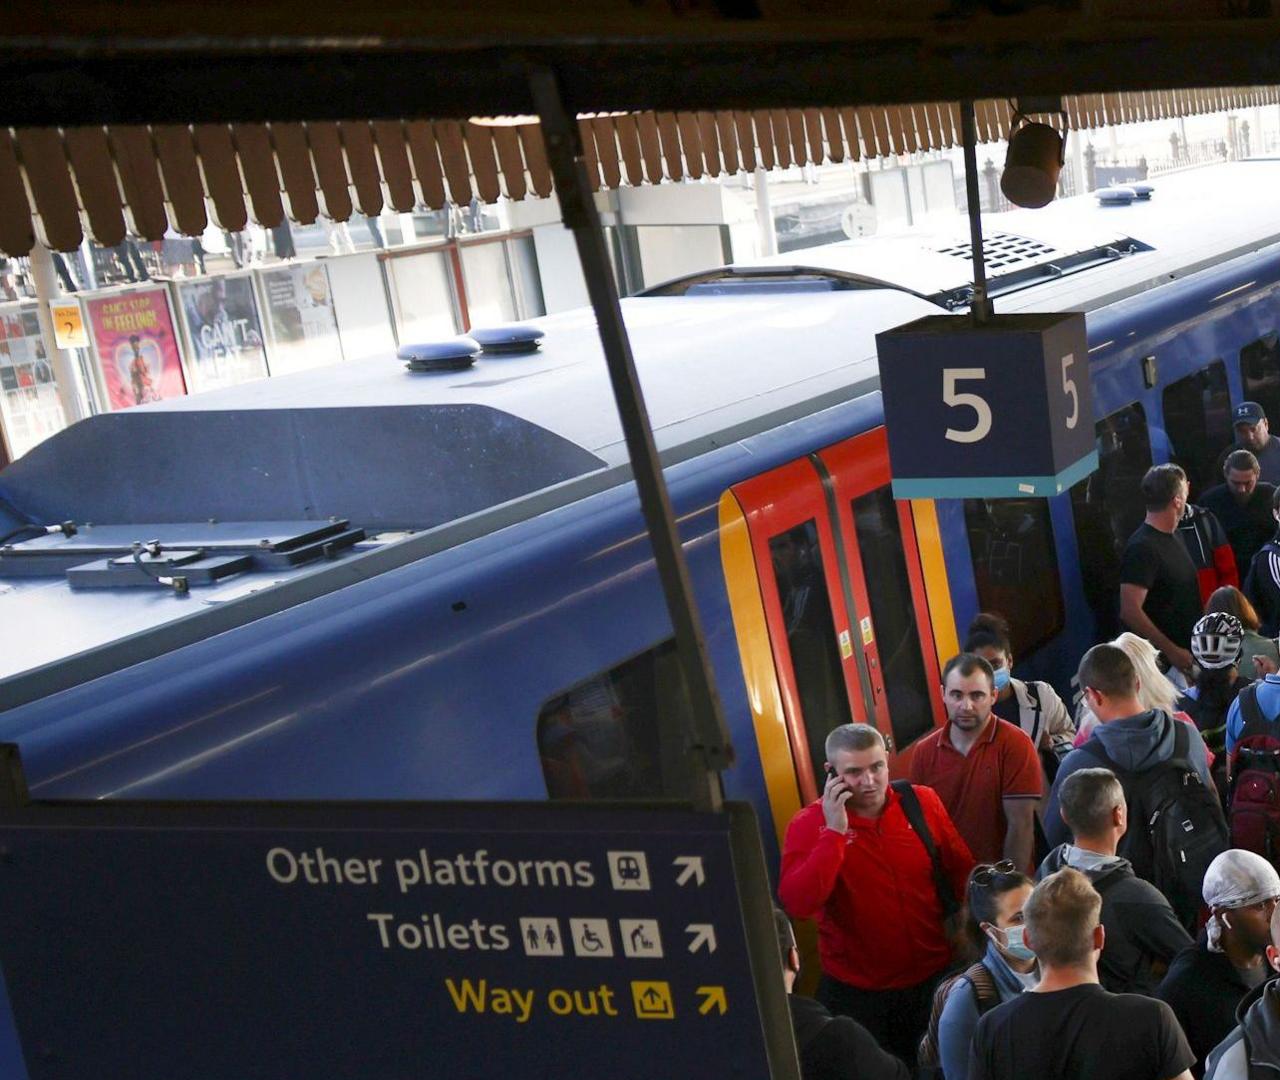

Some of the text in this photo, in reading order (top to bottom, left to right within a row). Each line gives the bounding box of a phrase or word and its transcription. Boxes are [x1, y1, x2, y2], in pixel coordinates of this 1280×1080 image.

[943, 367, 992, 443] 5
[1061, 353, 1079, 429] 5
[265, 847, 595, 892] Other platforms
[366, 912, 510, 951] Toilets
[445, 978, 618, 1023] Way out
